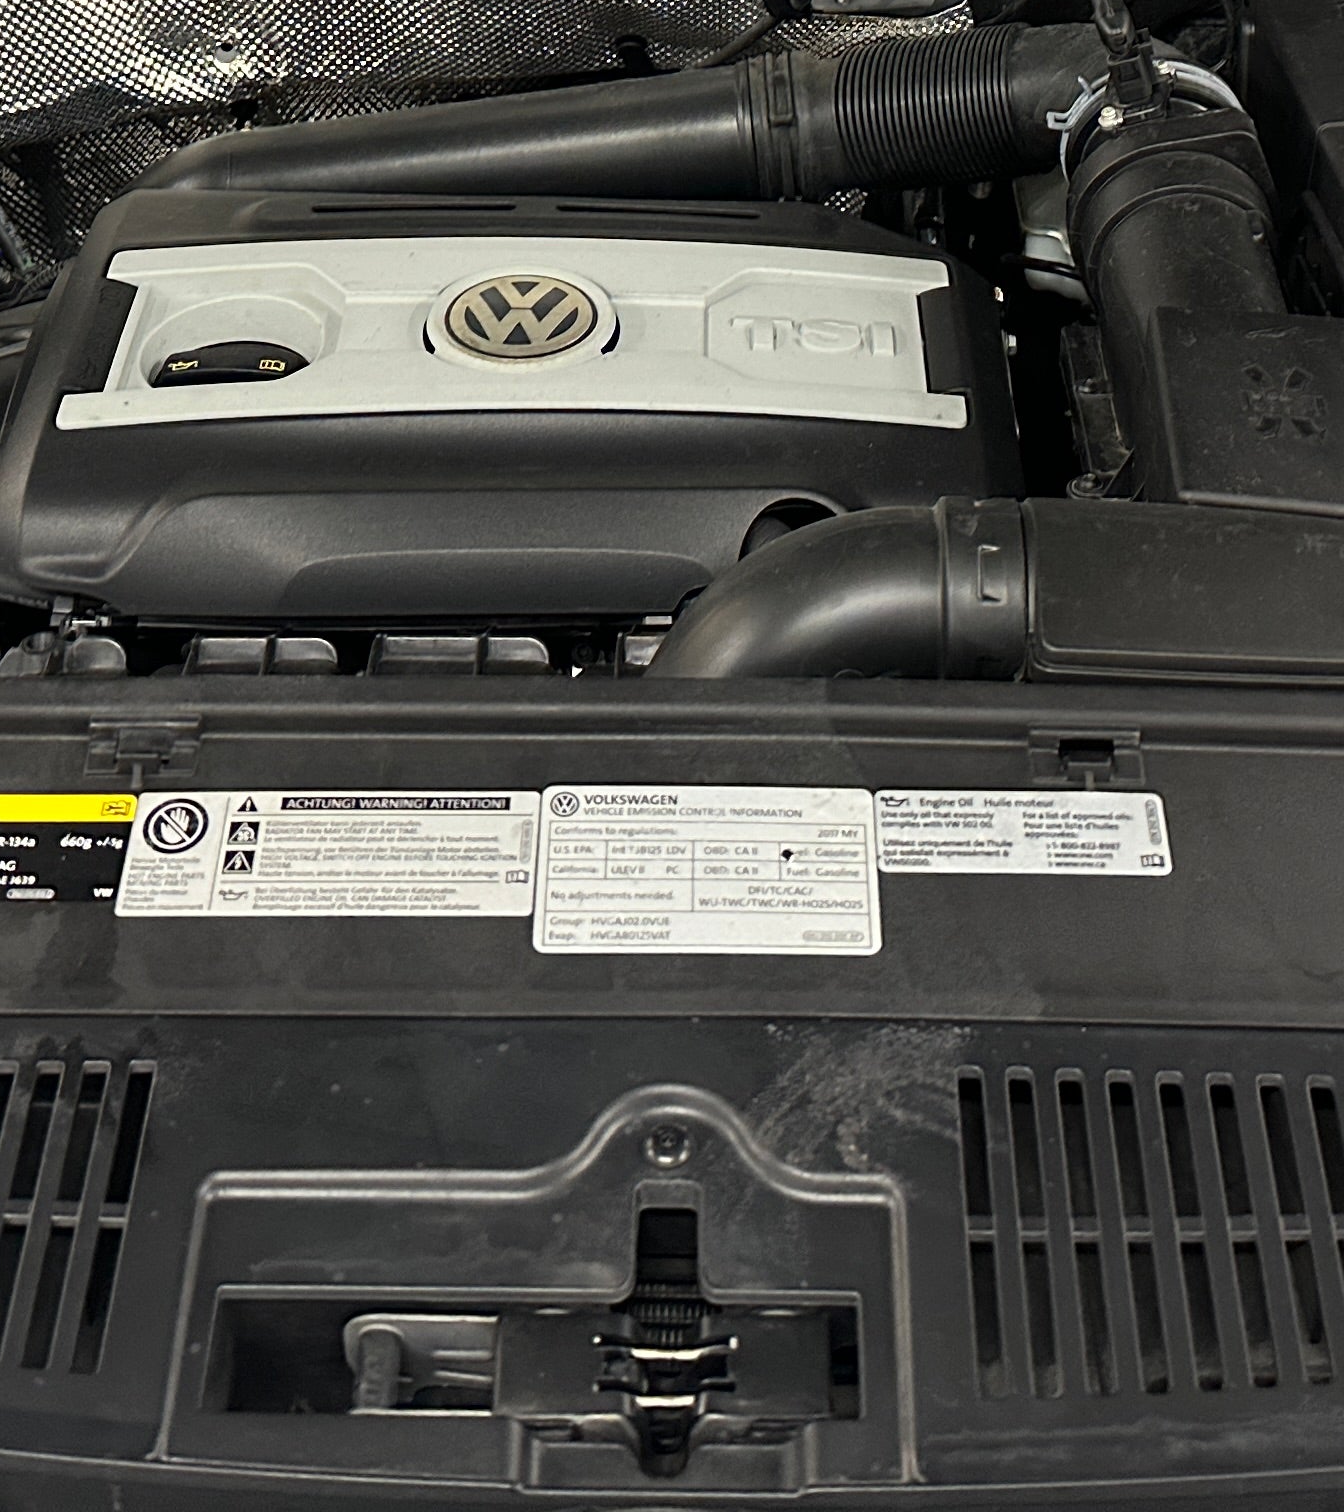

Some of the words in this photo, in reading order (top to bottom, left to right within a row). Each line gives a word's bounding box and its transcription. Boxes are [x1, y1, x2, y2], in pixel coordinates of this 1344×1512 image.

[446, 273, 598, 360] VW
[732, 316, 899, 358] TSI
[286, 798, 356, 809] ACHTUNG!
[359, 798, 427, 809] WARNING!
[430, 798, 506, 809] ATTENTION!
[584, 795, 678, 805] VOLKSWAGEN
[919, 798, 955, 809] Engine
[958, 798, 973, 807] Oil
[984, 798, 1012, 807] Huile
[1014, 799, 1054, 807] moteur
[584, 807, 624, 816] VEHICLE
[627, 807, 676, 816] EMISSION
[729, 808, 802, 818] INFORMATION
[666, 846, 688, 854] LDV
[734, 847, 749, 855] CA
[666, 866, 680, 874] PC
[734, 867, 749, 875] CA
[9, 875, 36, 885] J639
[93, 888, 114, 897] VW
